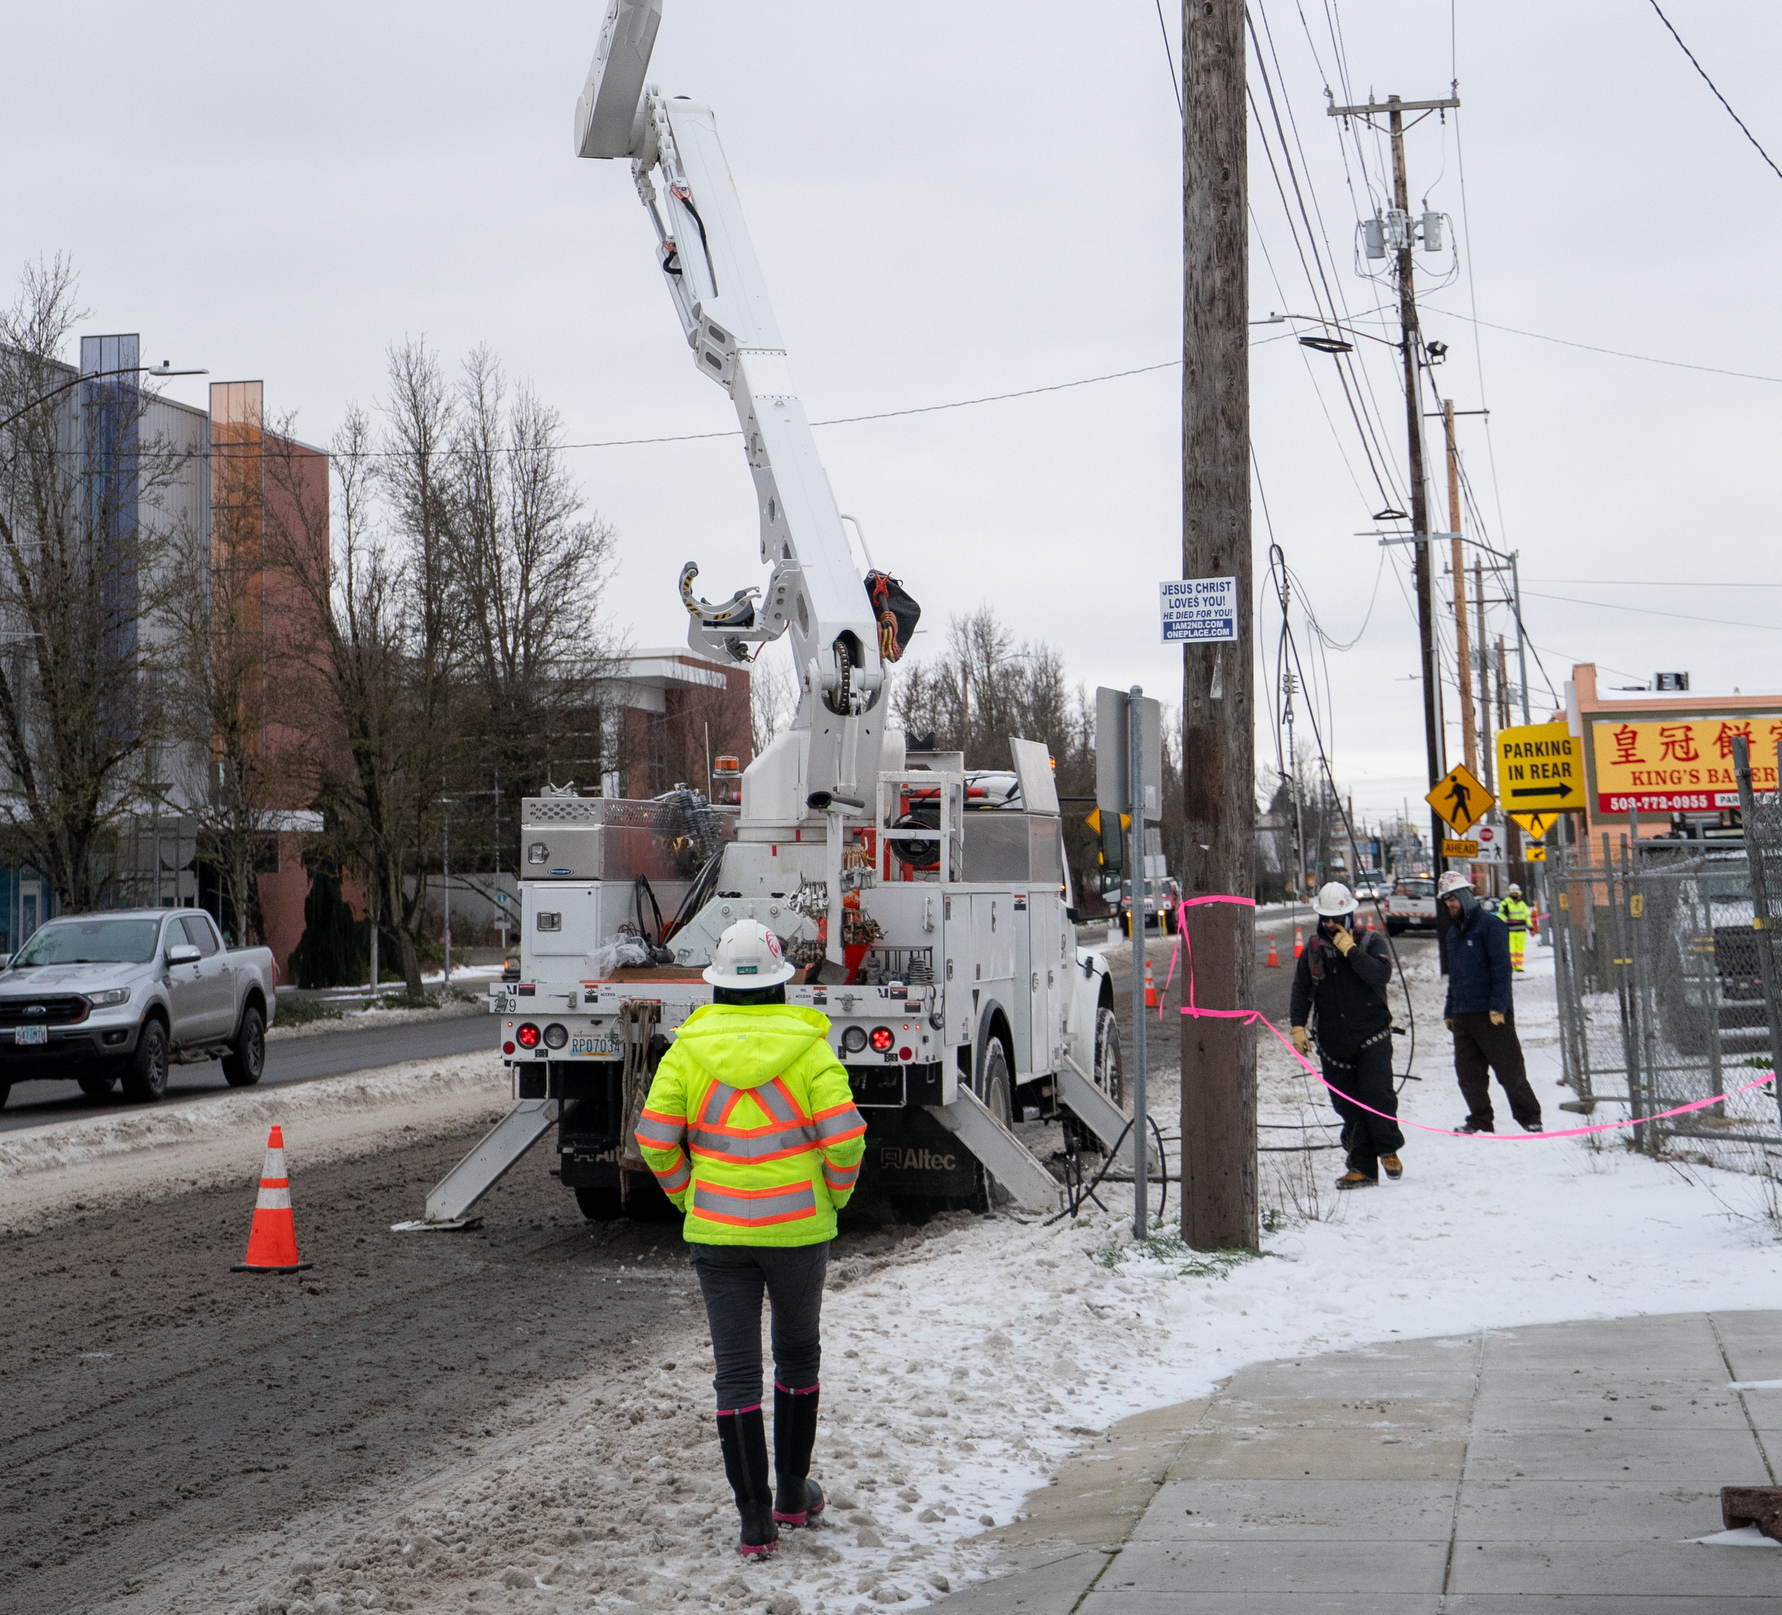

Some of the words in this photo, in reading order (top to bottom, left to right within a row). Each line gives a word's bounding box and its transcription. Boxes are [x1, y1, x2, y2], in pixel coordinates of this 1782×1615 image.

[1162, 583, 1193, 595] JESUS
[1195, 581, 1232, 594] CHRIST
[1169, 597, 1200, 609] LOVES
[1202, 595, 1226, 607] YOU!
[1163, 611, 1174, 620] HE
[1176, 610, 1194, 619] DIED
[1196, 609, 1212, 618] FOR
[1214, 608, 1233, 617] YOU!
[1172, 620, 1224, 630] IAM2ND.COM
[1166, 628, 1230, 638] ONEPLACE.COM
[1503, 740, 1572, 759] PARKING
[1610, 722, 1782, 766] 皇冠餅
[1508, 765, 1524, 781] IN
[1530, 762, 1572, 780] REAR
[1631, 769, 1701, 786] KING'S
[1706, 767, 1778, 784] BAER
[1610, 794, 1708, 811] 503-772-0955
[1445, 843, 1475, 855] AHEAD
[572, 1038, 620, 1053] RP07034
[903, 1148, 956, 1171] Altec
